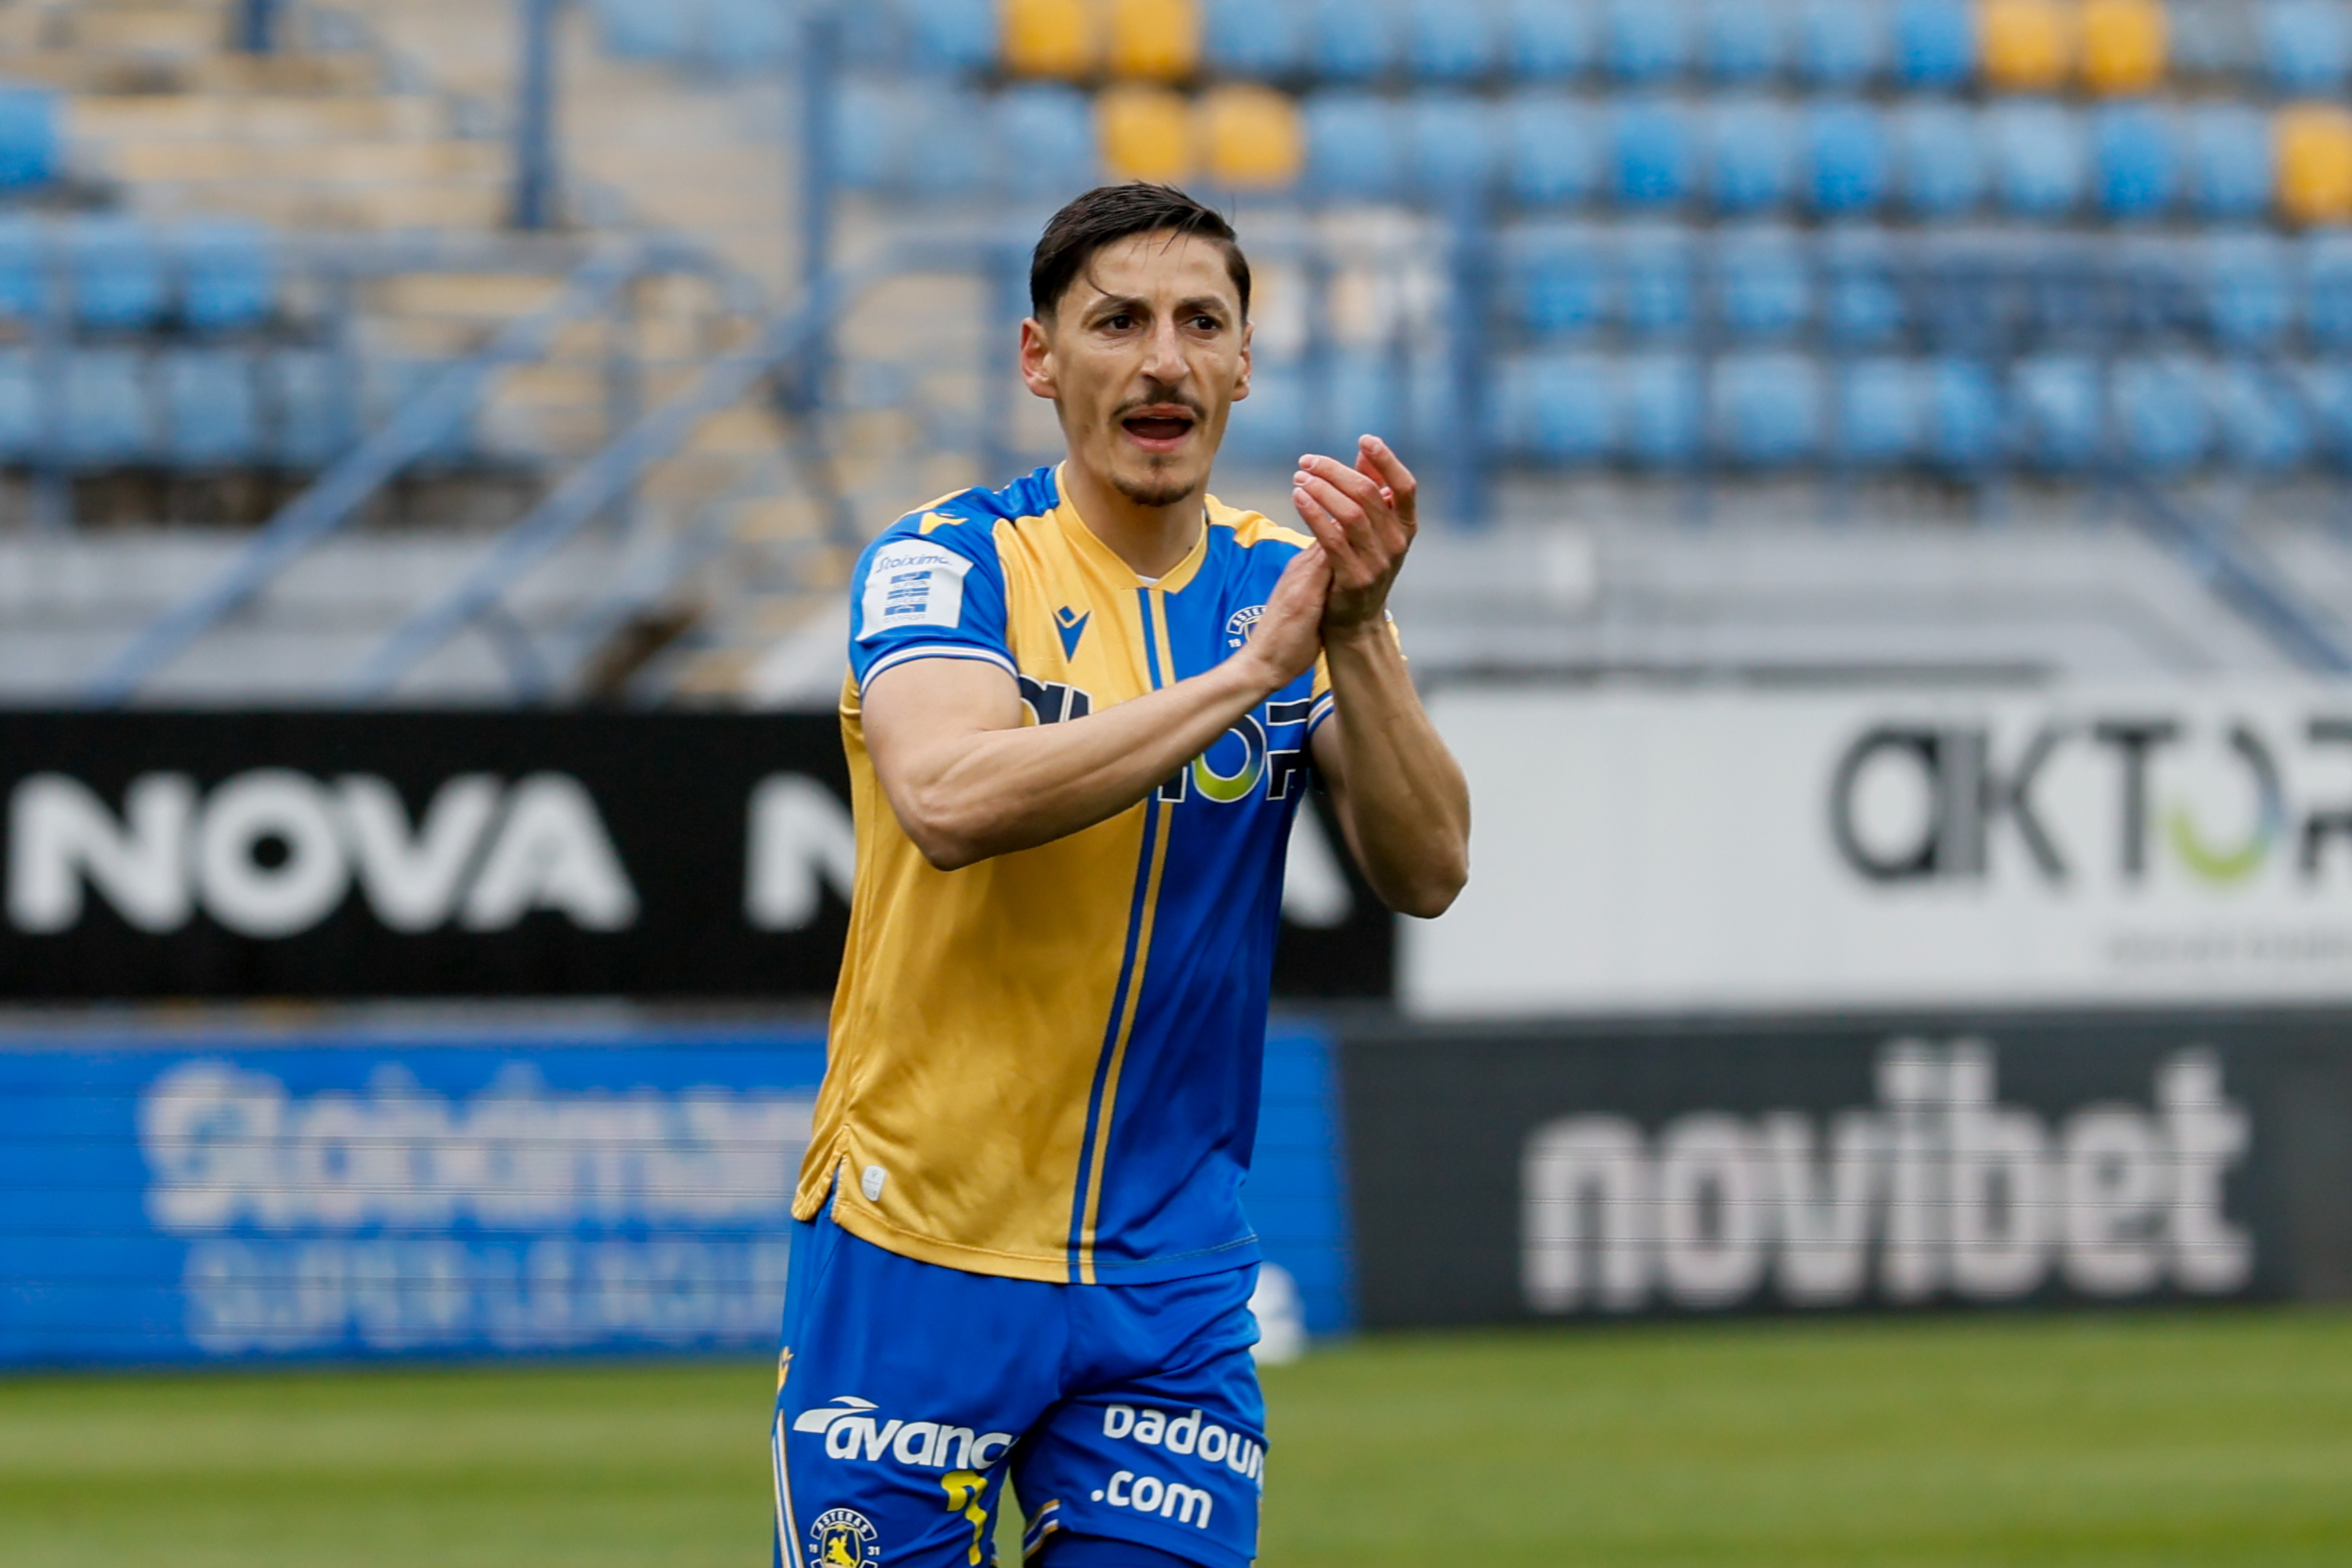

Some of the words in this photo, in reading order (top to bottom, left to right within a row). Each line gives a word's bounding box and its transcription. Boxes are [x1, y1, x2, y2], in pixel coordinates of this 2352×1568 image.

[1232, 607, 1268, 627] ASTE
[9, 769, 639, 937] NOVA
[1522, 1039, 2252, 1310] novibet
[825, 1416, 1020, 1470] avanc
[817, 1511, 870, 1533] ASTERAS
[1091, 1471, 1213, 1529] .com
[868, 1545, 880, 1556] 31
